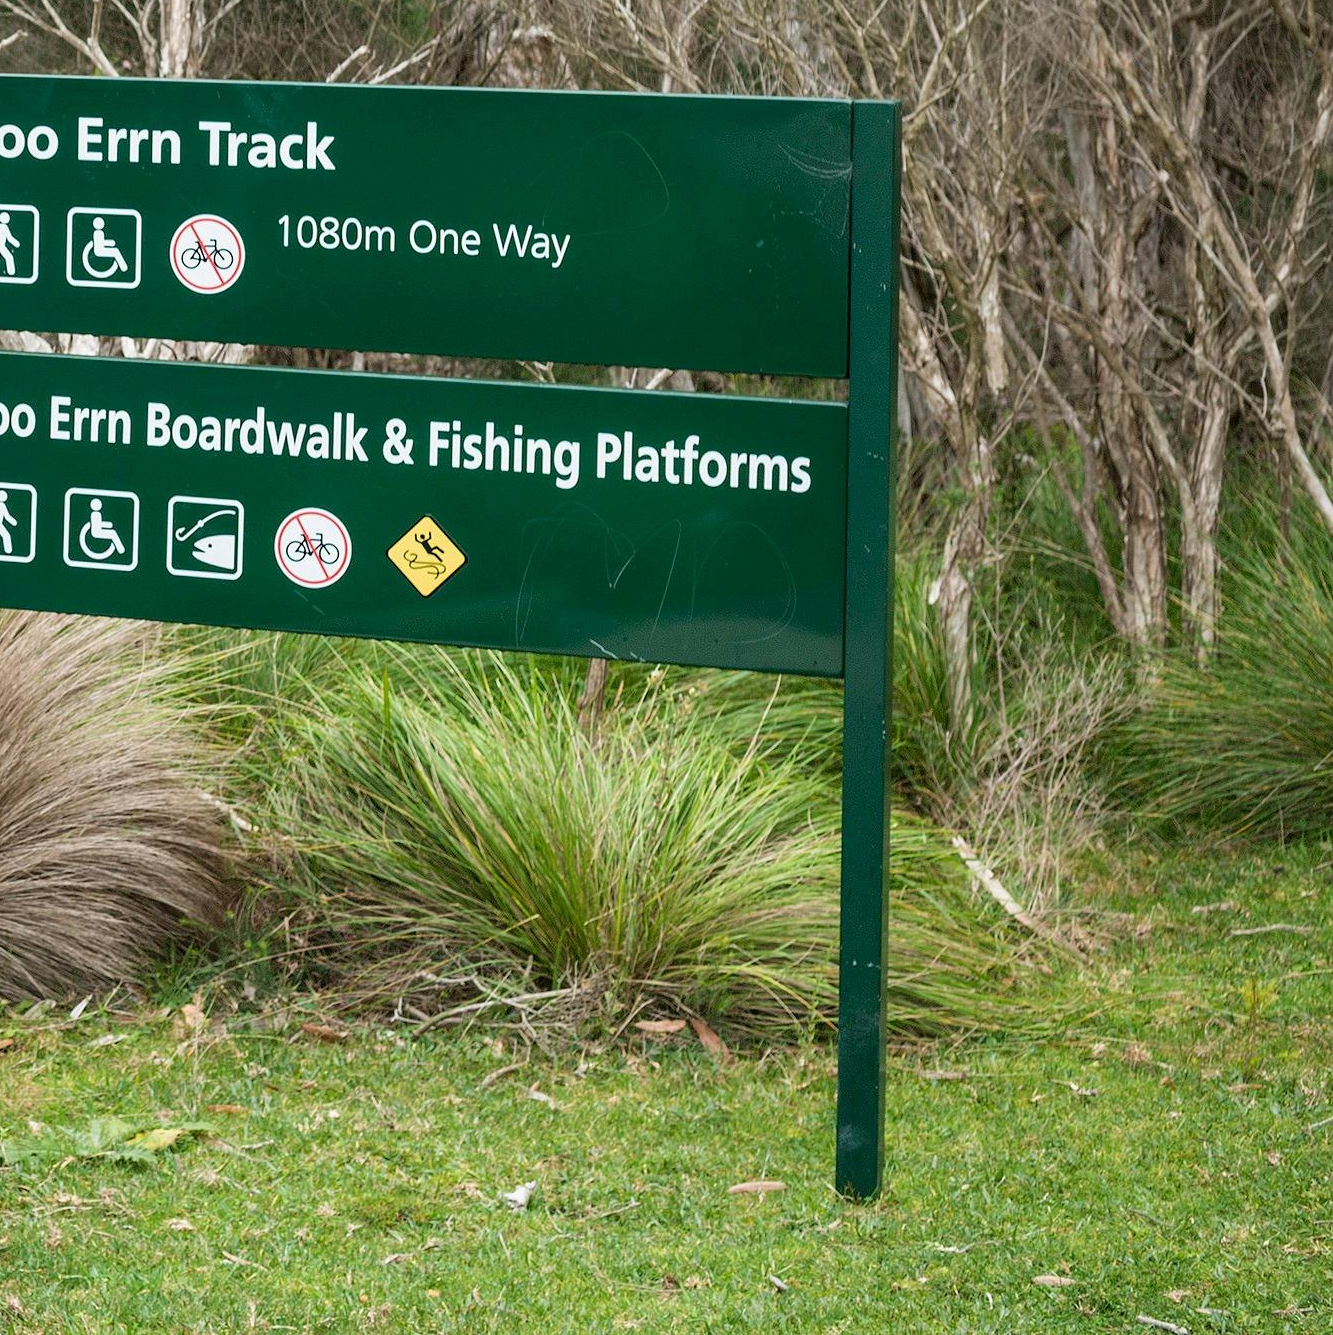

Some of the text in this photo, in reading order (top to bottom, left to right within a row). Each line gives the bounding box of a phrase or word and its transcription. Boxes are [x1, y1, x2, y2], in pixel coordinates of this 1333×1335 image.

[77, 116, 182, 166] Errn
[198, 120, 336, 171] Track
[277, 214, 571, 270] 1080m One Way
[49, 395, 132, 446] Errn
[146, 402, 369, 463] Boardwalk
[382, 417, 415, 466] &
[428, 420, 581, 491] Fishing
[596, 430, 813, 495] Platforms
